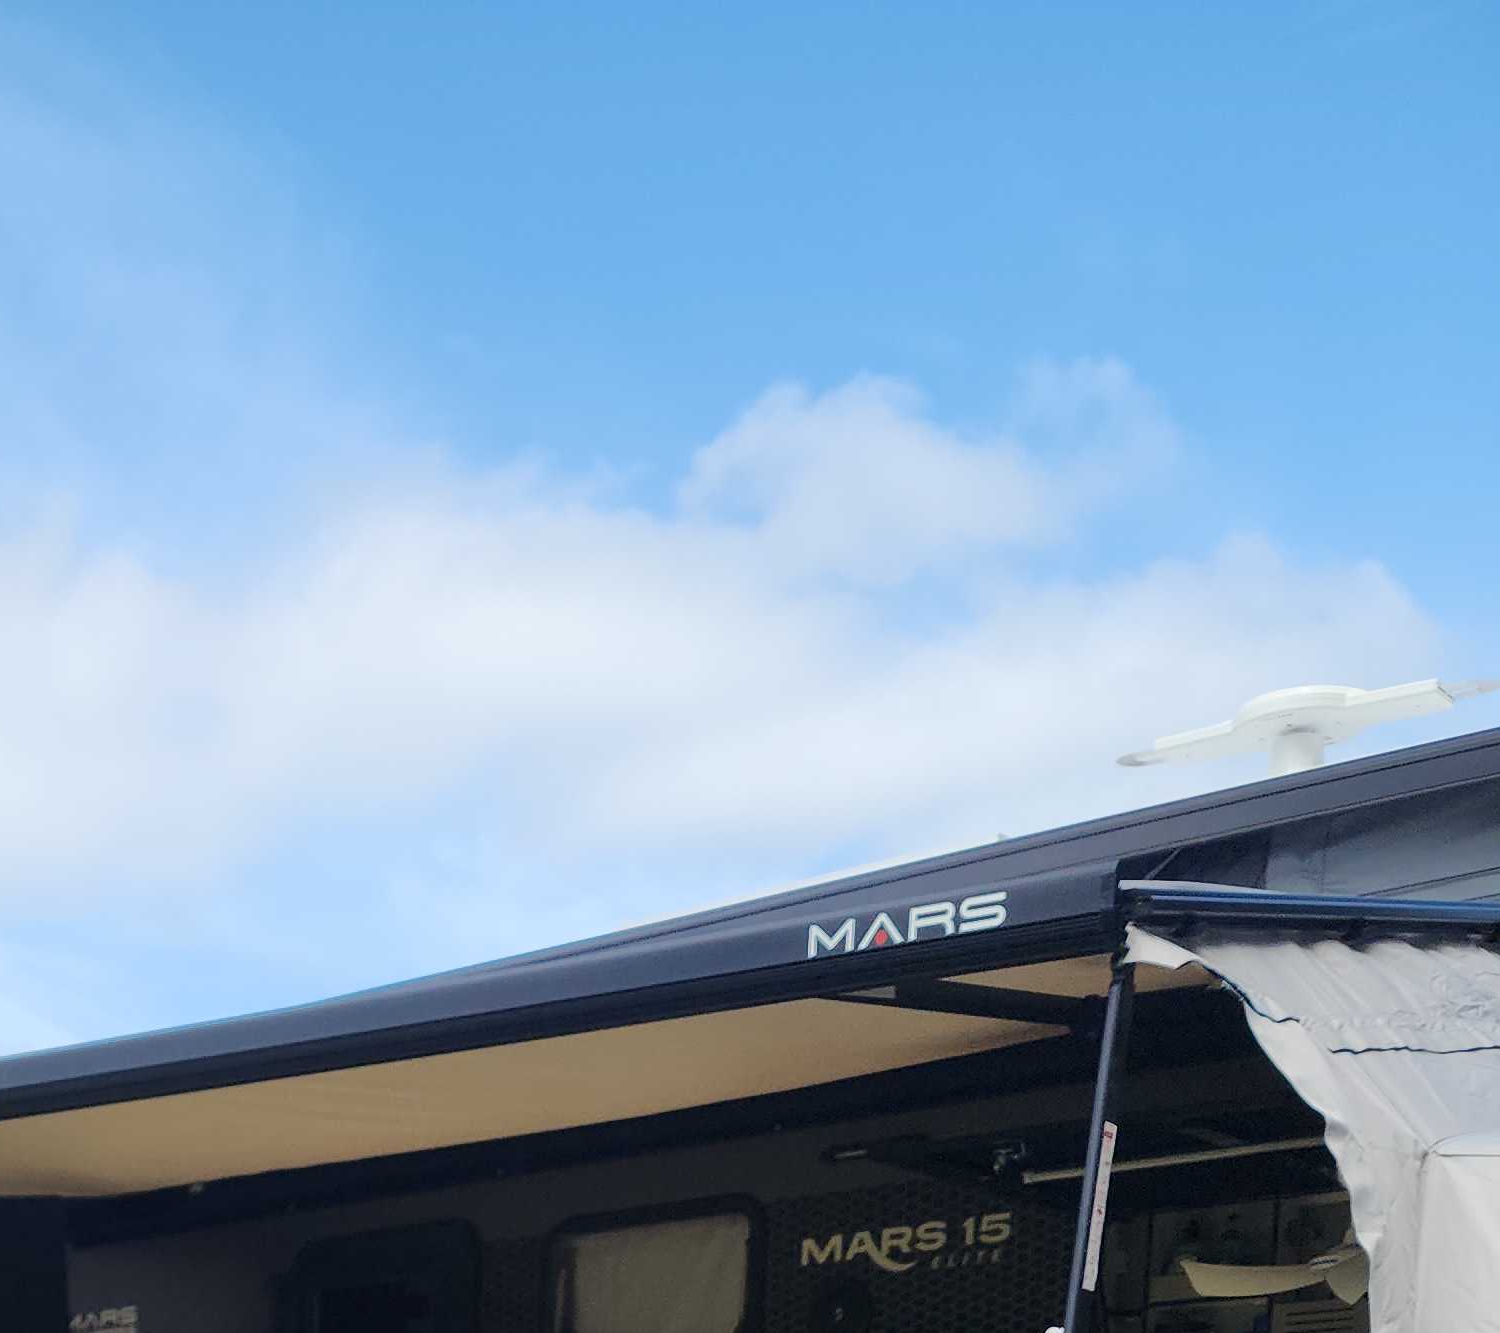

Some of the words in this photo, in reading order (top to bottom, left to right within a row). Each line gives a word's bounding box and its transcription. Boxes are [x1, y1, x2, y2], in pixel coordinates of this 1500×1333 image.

[807, 891, 1008, 959] MARS
[801, 1220, 947, 1271] MARS
[962, 1211, 1013, 1246] 15
